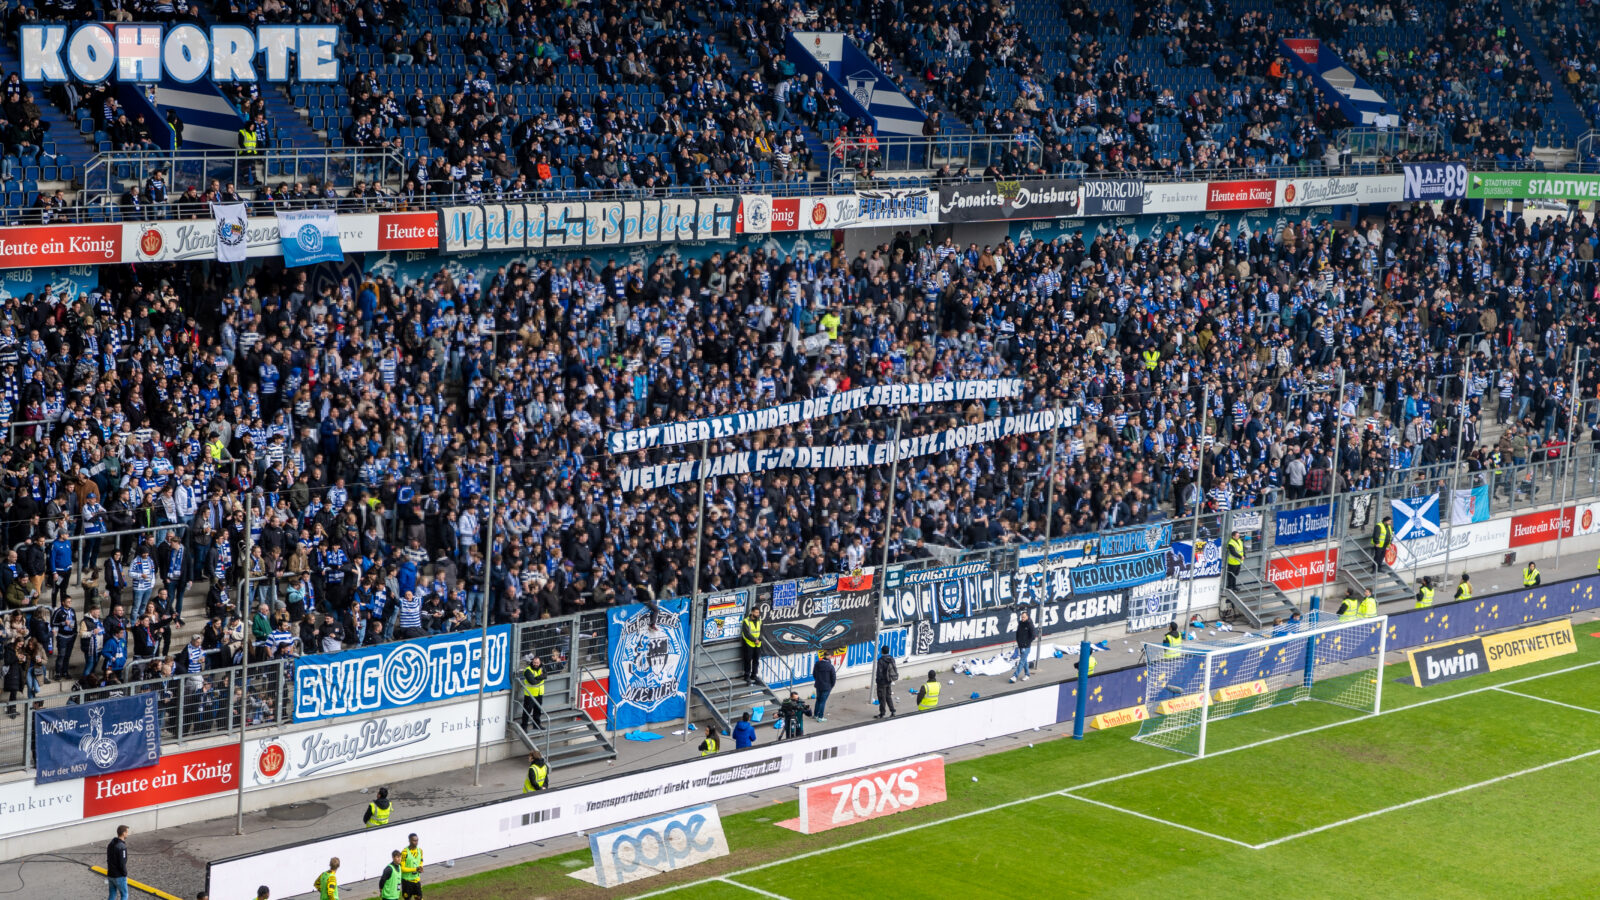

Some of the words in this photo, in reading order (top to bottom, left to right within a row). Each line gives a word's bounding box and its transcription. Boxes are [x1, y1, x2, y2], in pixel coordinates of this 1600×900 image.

[1484, 178, 1522, 187] STADTWERKE
[1528, 179, 1600, 196] STADTWE
[1011, 186, 1079, 210] Duisburg
[1101, 198, 1126, 213] MCMII
[1211, 189, 1234, 202] Heute
[1236, 187, 1249, 200] ein
[1250, 185, 1273, 204] König
[772, 207, 795, 227] önig
[386, 223, 424, 240] Heute
[427, 222, 439, 238] ei
[44, 237, 65, 254] ein
[67, 235, 115, 258] König
[611, 427, 660, 454] SEIT
[663, 420, 711, 446] ÜBER
[712, 417, 736, 438] 25
[736, 402, 800, 436] JAHREN
[802, 396, 832, 420] DIE
[831, 386, 871, 415] GUTE
[868, 383, 921, 406] SEELE
[919, 381, 952, 405] DES
[953, 377, 1024, 400] VEREINS
[619, 459, 698, 493] VIELEN
[697, 451, 752, 480] DANK
[755, 447, 796, 472] FÜR
[795, 444, 869, 470] DEINEN
[945, 416, 1001, 448] ROBERT
[1514, 522, 1536, 538] Heute
[1537, 519, 1549, 533] ein
[1071, 553, 1165, 590] WEDAUSTADION
[1267, 567, 1293, 583] Heute
[938, 615, 1000, 644] IMMER
[1063, 592, 1122, 623] GEBEN!
[1426, 648, 1479, 681] bwin
[1488, 628, 1572, 661] SPORTWETTEN
[296, 653, 384, 719] EWIG
[426, 631, 508, 699] TREU
[580, 692, 608, 711] Heu
[145, 697, 157, 761] DUISBURG
[1102, 712, 1132, 729] Sinalco
[297, 728, 359, 770] König
[358, 717, 432, 753] Pilsener
[41, 769, 56, 778] Nur
[58, 766, 70, 776] der
[70, 763, 88, 774] MSV
[95, 777, 149, 801] Heute
[151, 772, 178, 790] ein
[181, 759, 233, 785] König
[662, 778, 690, 795] direkt
[691, 776, 708, 789] von
[830, 768, 920, 824] ZOXS
[611, 813, 715, 884] pape
